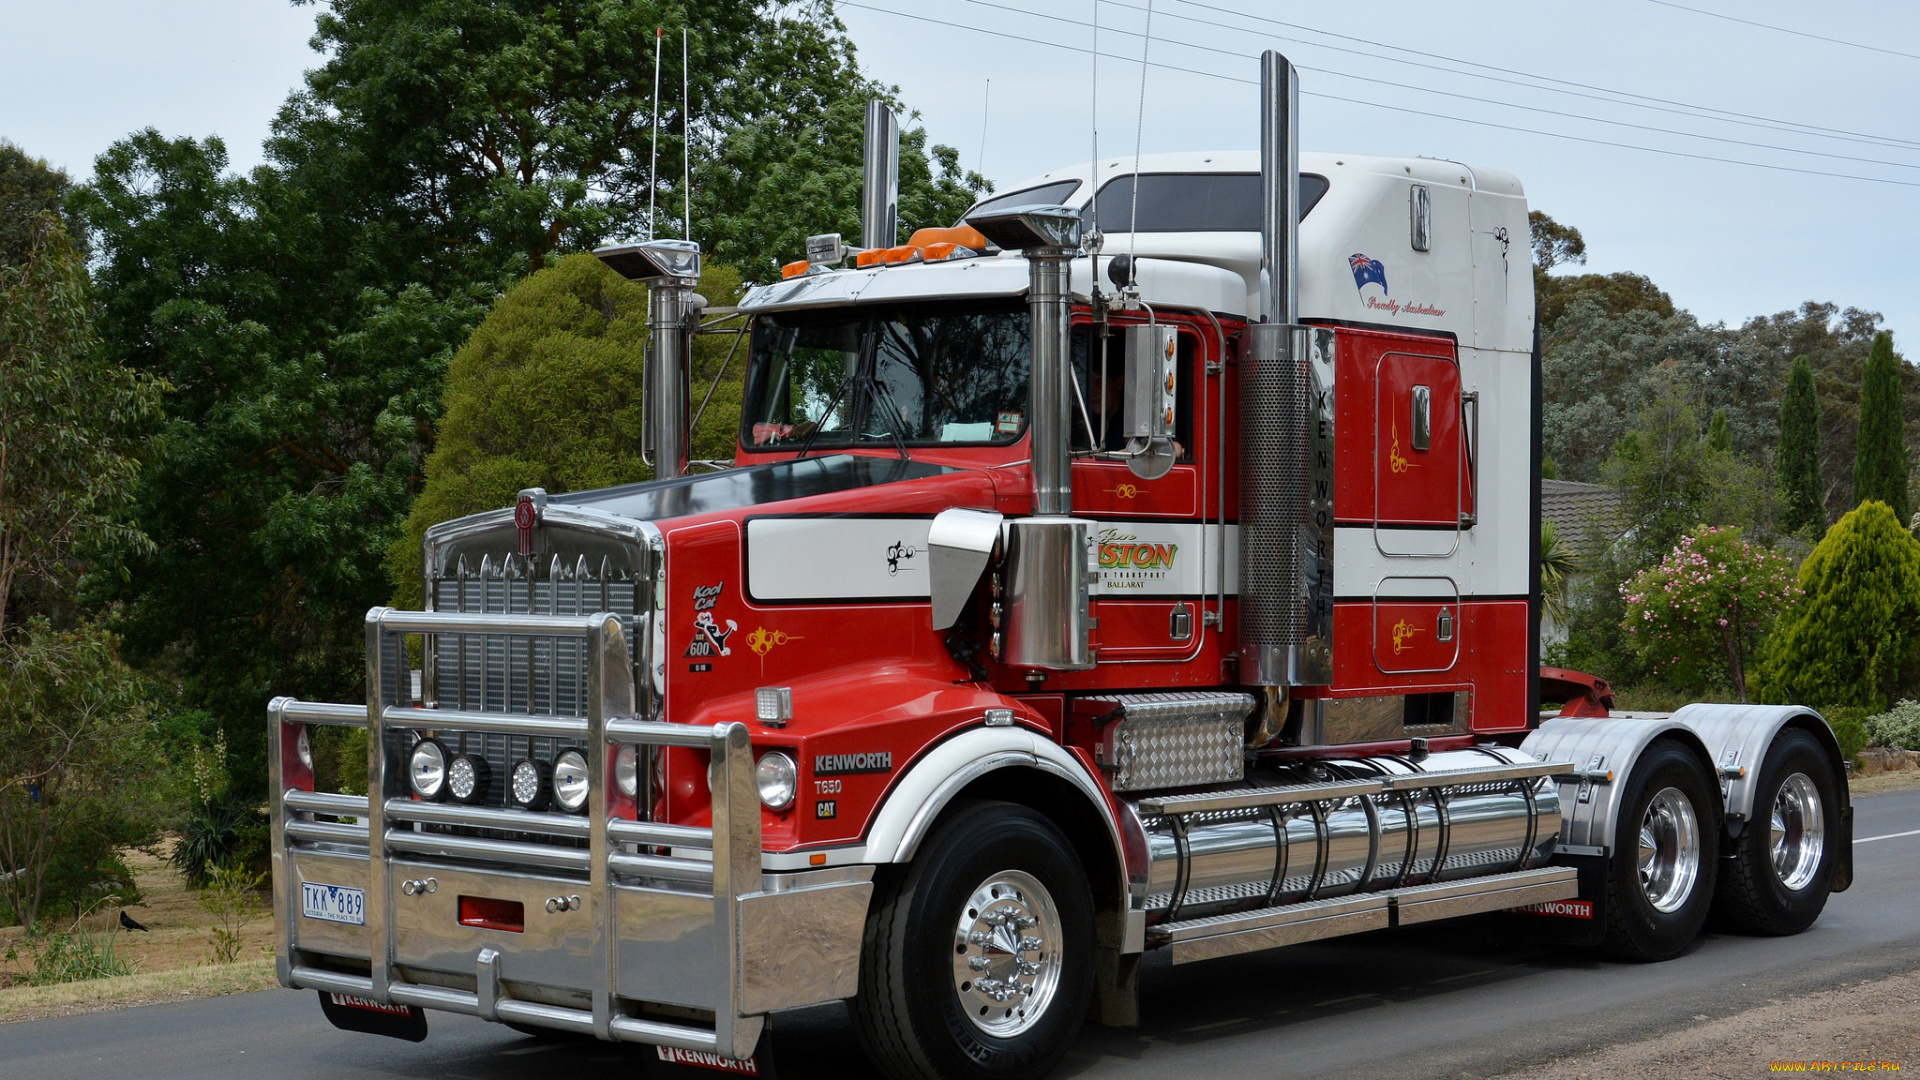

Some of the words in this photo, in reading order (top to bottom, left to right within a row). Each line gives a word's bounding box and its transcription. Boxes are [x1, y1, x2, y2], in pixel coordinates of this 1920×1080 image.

[1367, 296, 1400, 316] Proudly
[1401, 301, 1446, 317] Australian
[1315, 390, 1329, 618] KENWORTH
[693, 581, 724, 600] Kool
[694, 597, 717, 611] Cat
[690, 642, 710, 656] 600
[815, 752, 892, 773] KENWORTH
[814, 780, 842, 794] T650
[817, 802, 835, 817] CAT
[304, 886, 328, 911] TKK
[338, 892, 362, 916] 889
